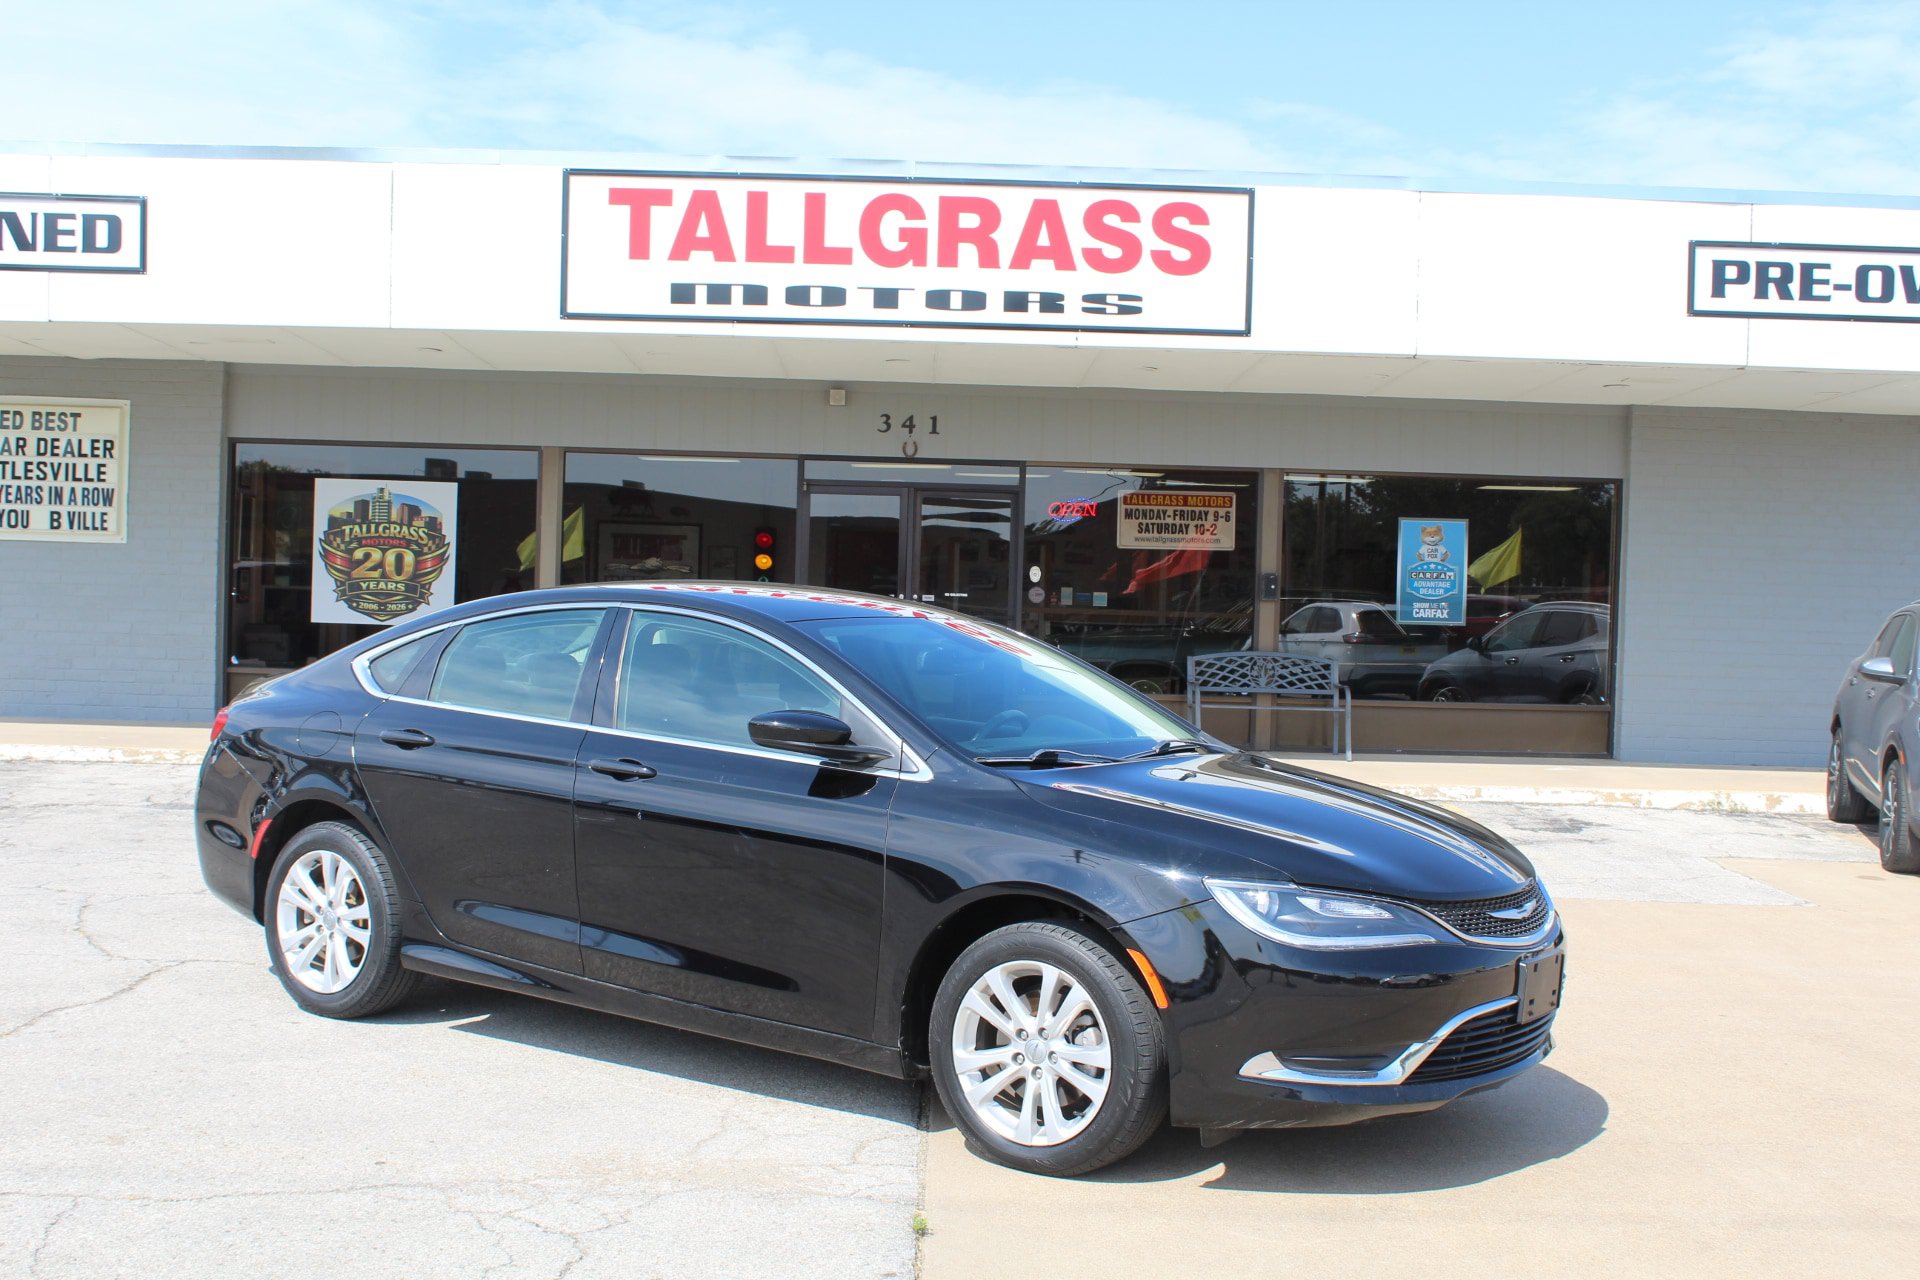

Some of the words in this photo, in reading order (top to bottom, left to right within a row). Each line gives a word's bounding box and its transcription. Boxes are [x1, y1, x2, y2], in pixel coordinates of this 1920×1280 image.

[0, 211, 122, 254] NED
[607, 187, 1211, 276] TALLGRASS
[670, 282, 1143, 316] MOTORS
[0, 410, 24, 430] ED
[31, 411, 82, 432] BEST
[877, 413, 940, 434] 341
[0, 436, 27, 456] AR
[36, 437, 115, 459] DEALER
[0, 460, 107, 483] TLESVILLE
[48, 486, 63, 505] IN
[68, 486, 77, 506] A
[81, 487, 115, 507] ROW
[1126, 494, 1184, 506] TALLGRASS
[1187, 496, 1231, 507] MOTORS
[1047, 502, 1098, 517] OPEN
[1124, 508, 1210, 522] MONDAY-FRIDAY
[1213, 511, 1232, 522] 9-6
[67, 511, 108, 531] VILLE
[1137, 522, 1190, 535] SATURDAY
[1193, 523, 1218, 536] 10-2
[341, 523, 430, 544] TALLGRASS
[361, 538, 407, 546] MOTORS
[351, 547, 416, 581] 20
[1411, 572, 1454, 580] CARFAX
[359, 581, 406, 592] YEARS
[358, 602, 379, 611] 2006
[386, 603, 407, 611] 2026
[1413, 608, 1449, 618] CARFAX
